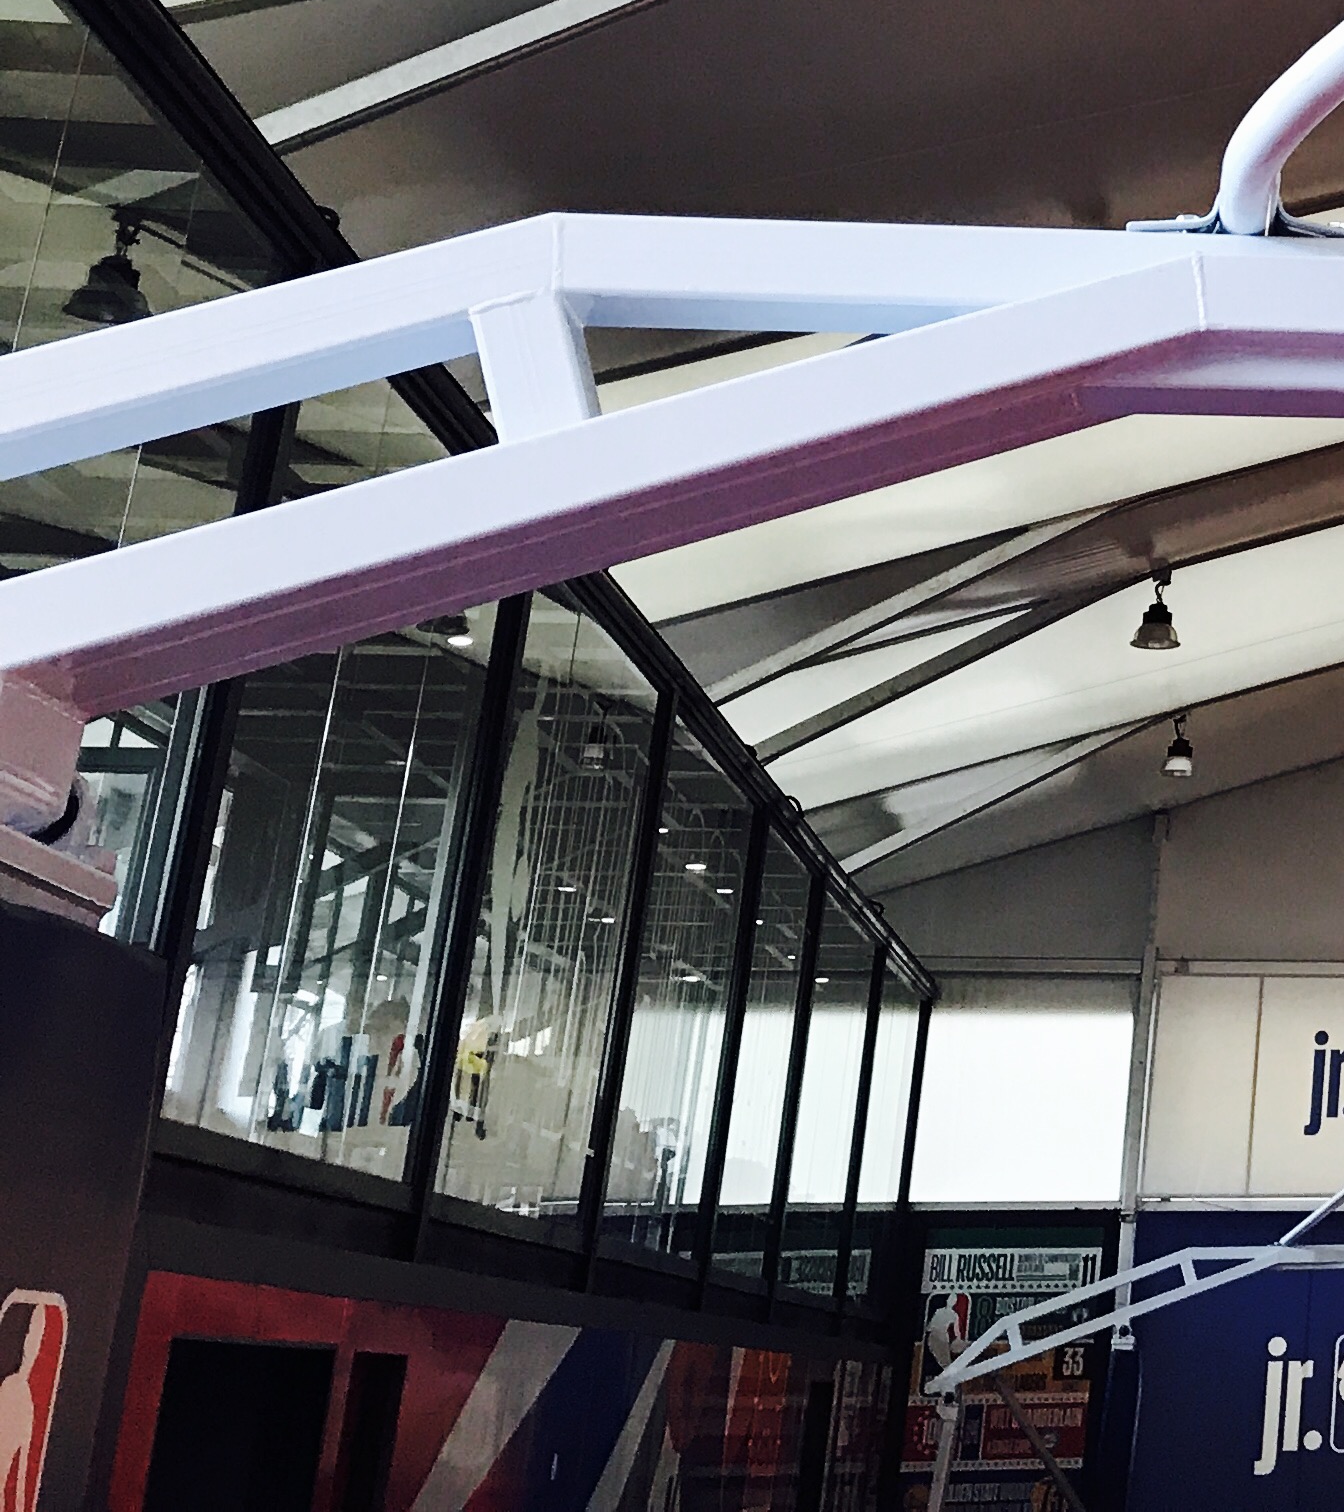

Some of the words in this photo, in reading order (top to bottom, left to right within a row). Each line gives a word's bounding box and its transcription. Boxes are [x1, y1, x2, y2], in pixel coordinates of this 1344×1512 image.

[929, 1254, 953, 1282] BILL
[955, 1253, 1015, 1282] RUSSELL
[1062, 1347, 1084, 1376] 33
[1254, 1336, 1323, 1475] jr.
